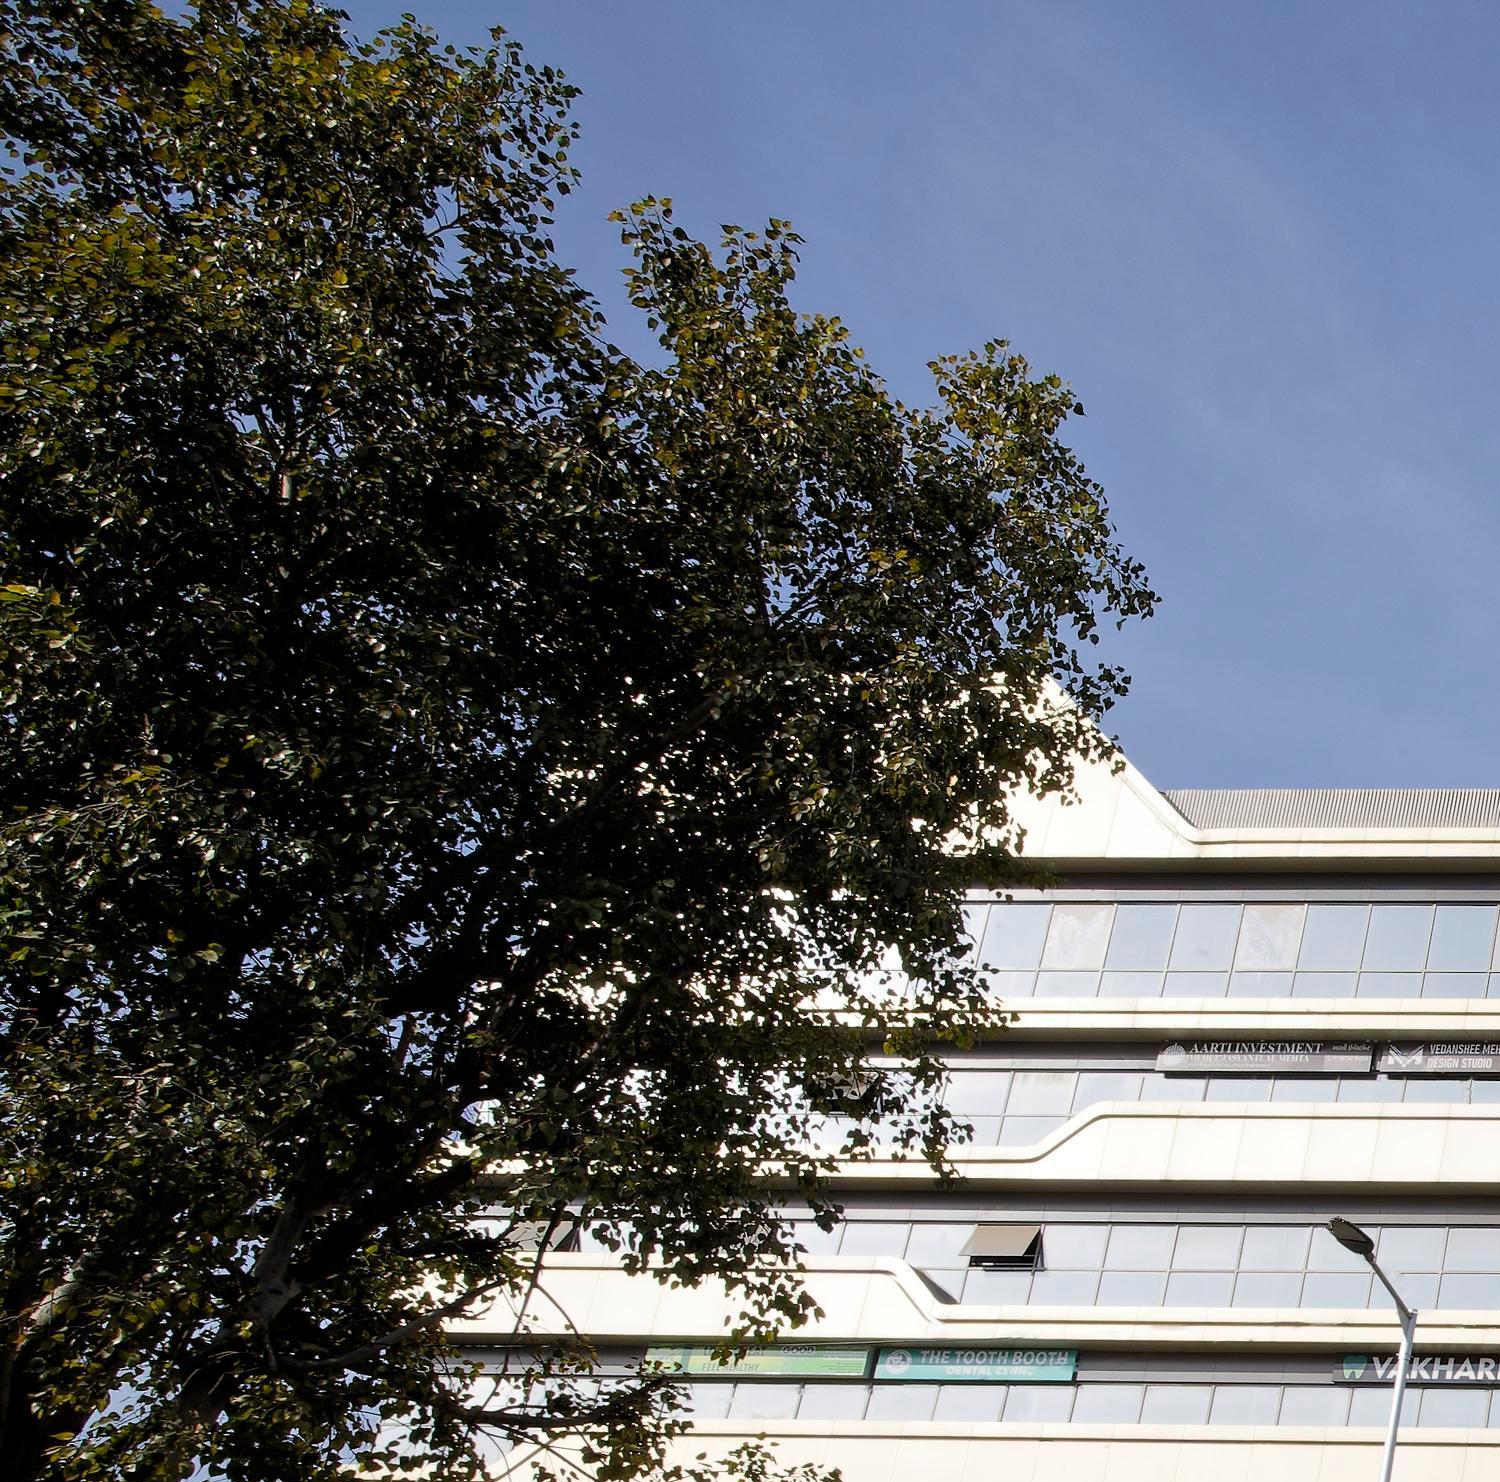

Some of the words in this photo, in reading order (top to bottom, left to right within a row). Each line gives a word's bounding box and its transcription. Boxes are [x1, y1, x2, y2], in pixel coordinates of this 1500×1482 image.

[1189, 1043, 1233, 1054] AARTI
[1235, 1043, 1324, 1054] INVESTMENT
[1430, 1045, 1481, 1055] VEDANSHEE
[1428, 1058, 1459, 1069] DESIGN
[1461, 1058, 1493, 1069] STUDIO
[920, 1350, 950, 1364] THE
[955, 1350, 1008, 1365] TOOTH
[1012, 1351, 1069, 1365] BOOTH
